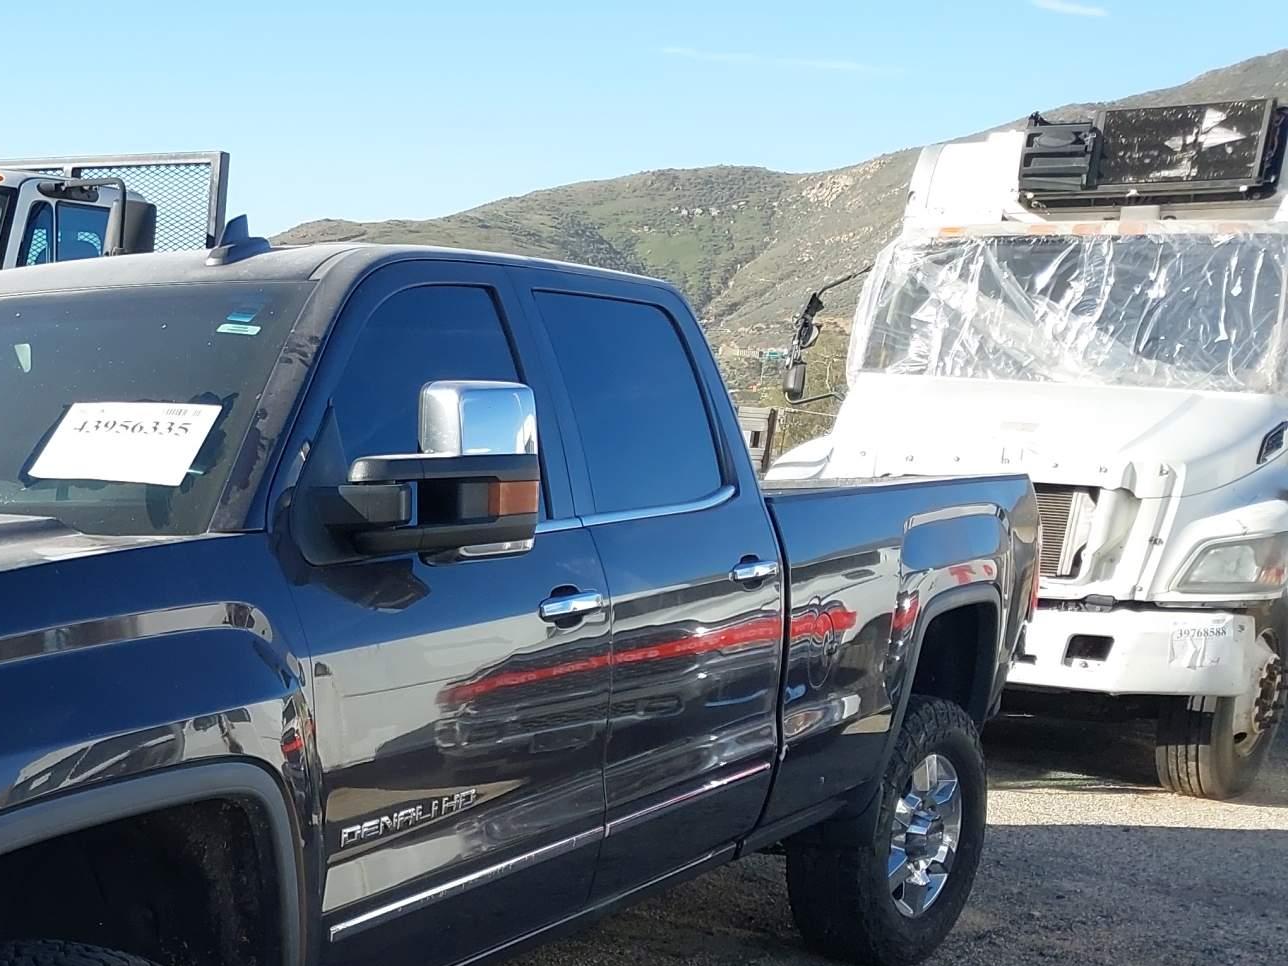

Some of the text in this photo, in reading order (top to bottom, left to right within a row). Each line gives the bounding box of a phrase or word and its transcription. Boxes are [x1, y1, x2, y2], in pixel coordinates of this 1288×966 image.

[74, 420, 192, 436] 43956335
[1177, 627, 1227, 640] 39768588
[340, 788, 477, 848] DENALI HD
